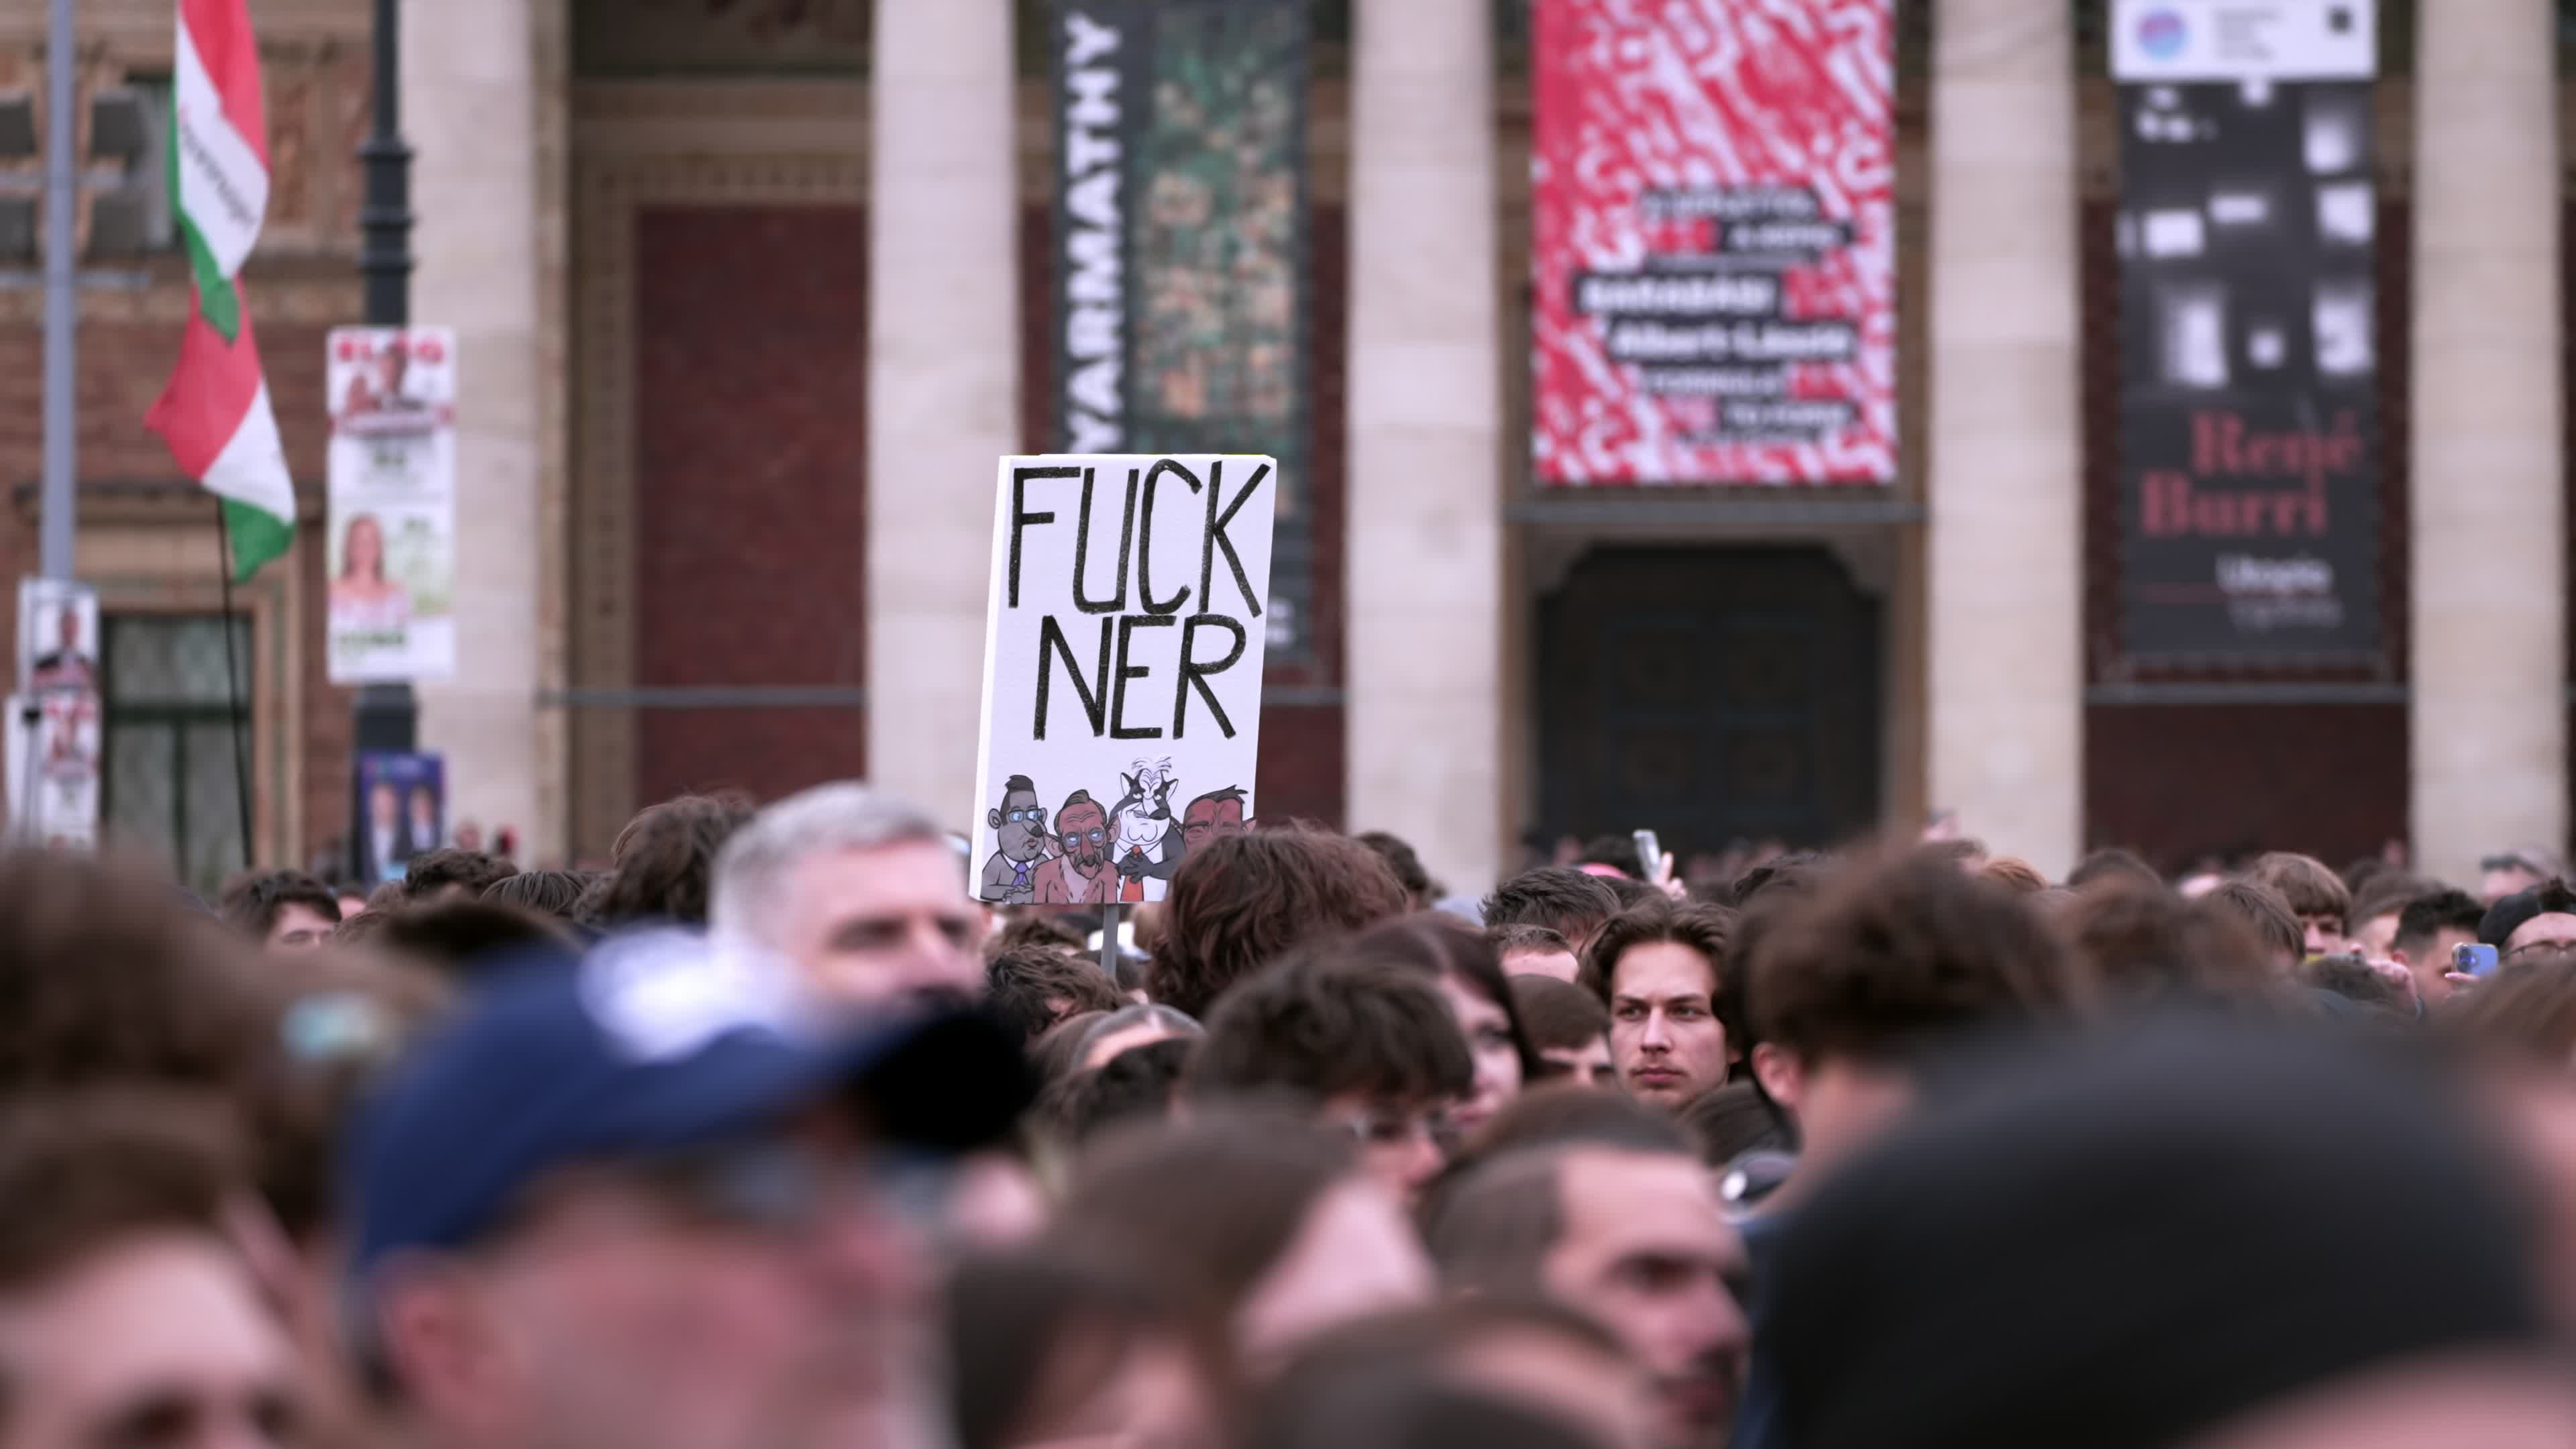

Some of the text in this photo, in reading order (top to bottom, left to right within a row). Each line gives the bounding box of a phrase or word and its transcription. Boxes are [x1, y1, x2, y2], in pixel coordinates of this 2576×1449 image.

[2192, 409, 2363, 475] René
[1008, 459, 1271, 618] FUCK
[2141, 470, 2327, 536] Burri
[1033, 614, 1246, 741] NER
